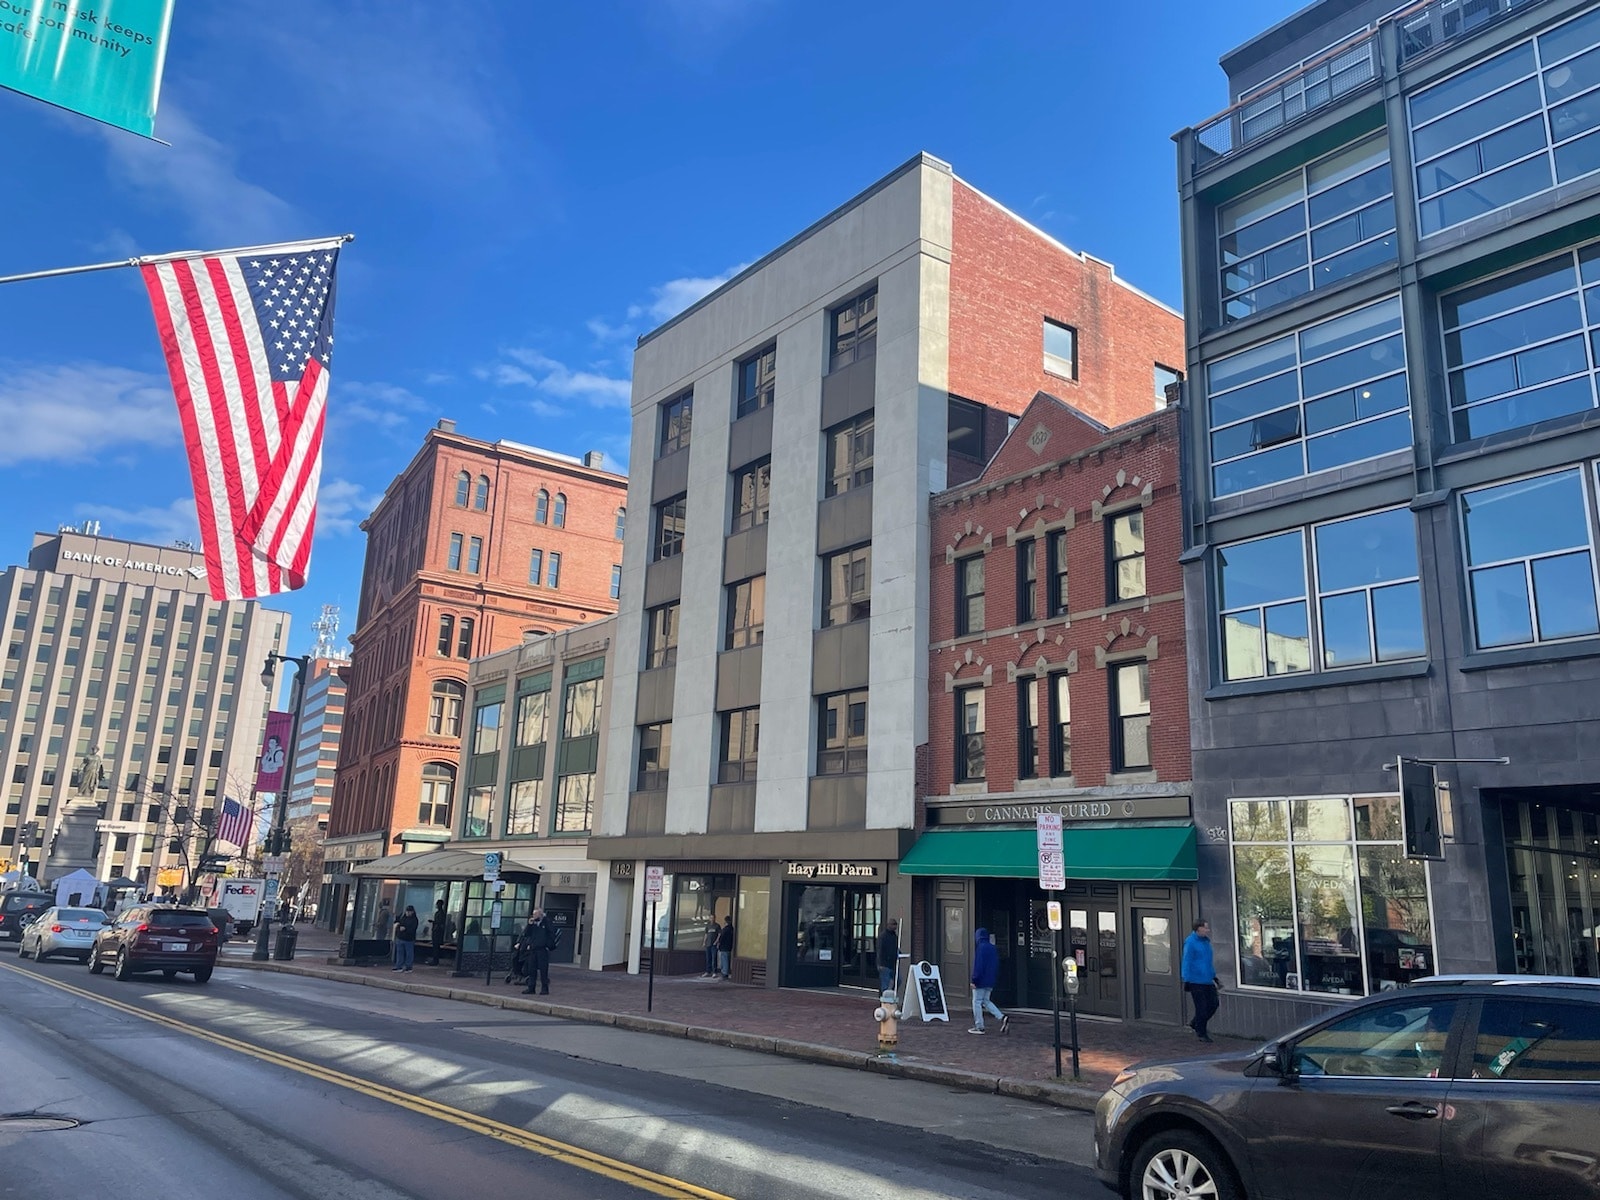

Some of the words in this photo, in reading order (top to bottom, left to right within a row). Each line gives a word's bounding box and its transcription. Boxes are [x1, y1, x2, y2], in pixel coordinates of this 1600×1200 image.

[0, 0, 31, 16] our
[37, 15, 131, 57] community
[0, 19, 37, 42] afe.
[104, 16, 153, 45] keeps
[63, 551, 101, 564] BANK
[104, 556, 122, 567] OF
[124, 559, 184, 577] AMERICA
[1059, 802, 1111, 818] CURED
[1044, 815, 1055, 823] NO
[1039, 823, 1061, 831] PARKING
[615, 863, 632, 875] 482
[787, 862, 815, 878] Hazy
[817, 863, 839, 875] Hill
[841, 863, 873, 876] Farm
[225, 884, 257, 895] FedEx
[1308, 879, 1347, 890] AVEDA
[1322, 976, 1345, 985] AVEDA
